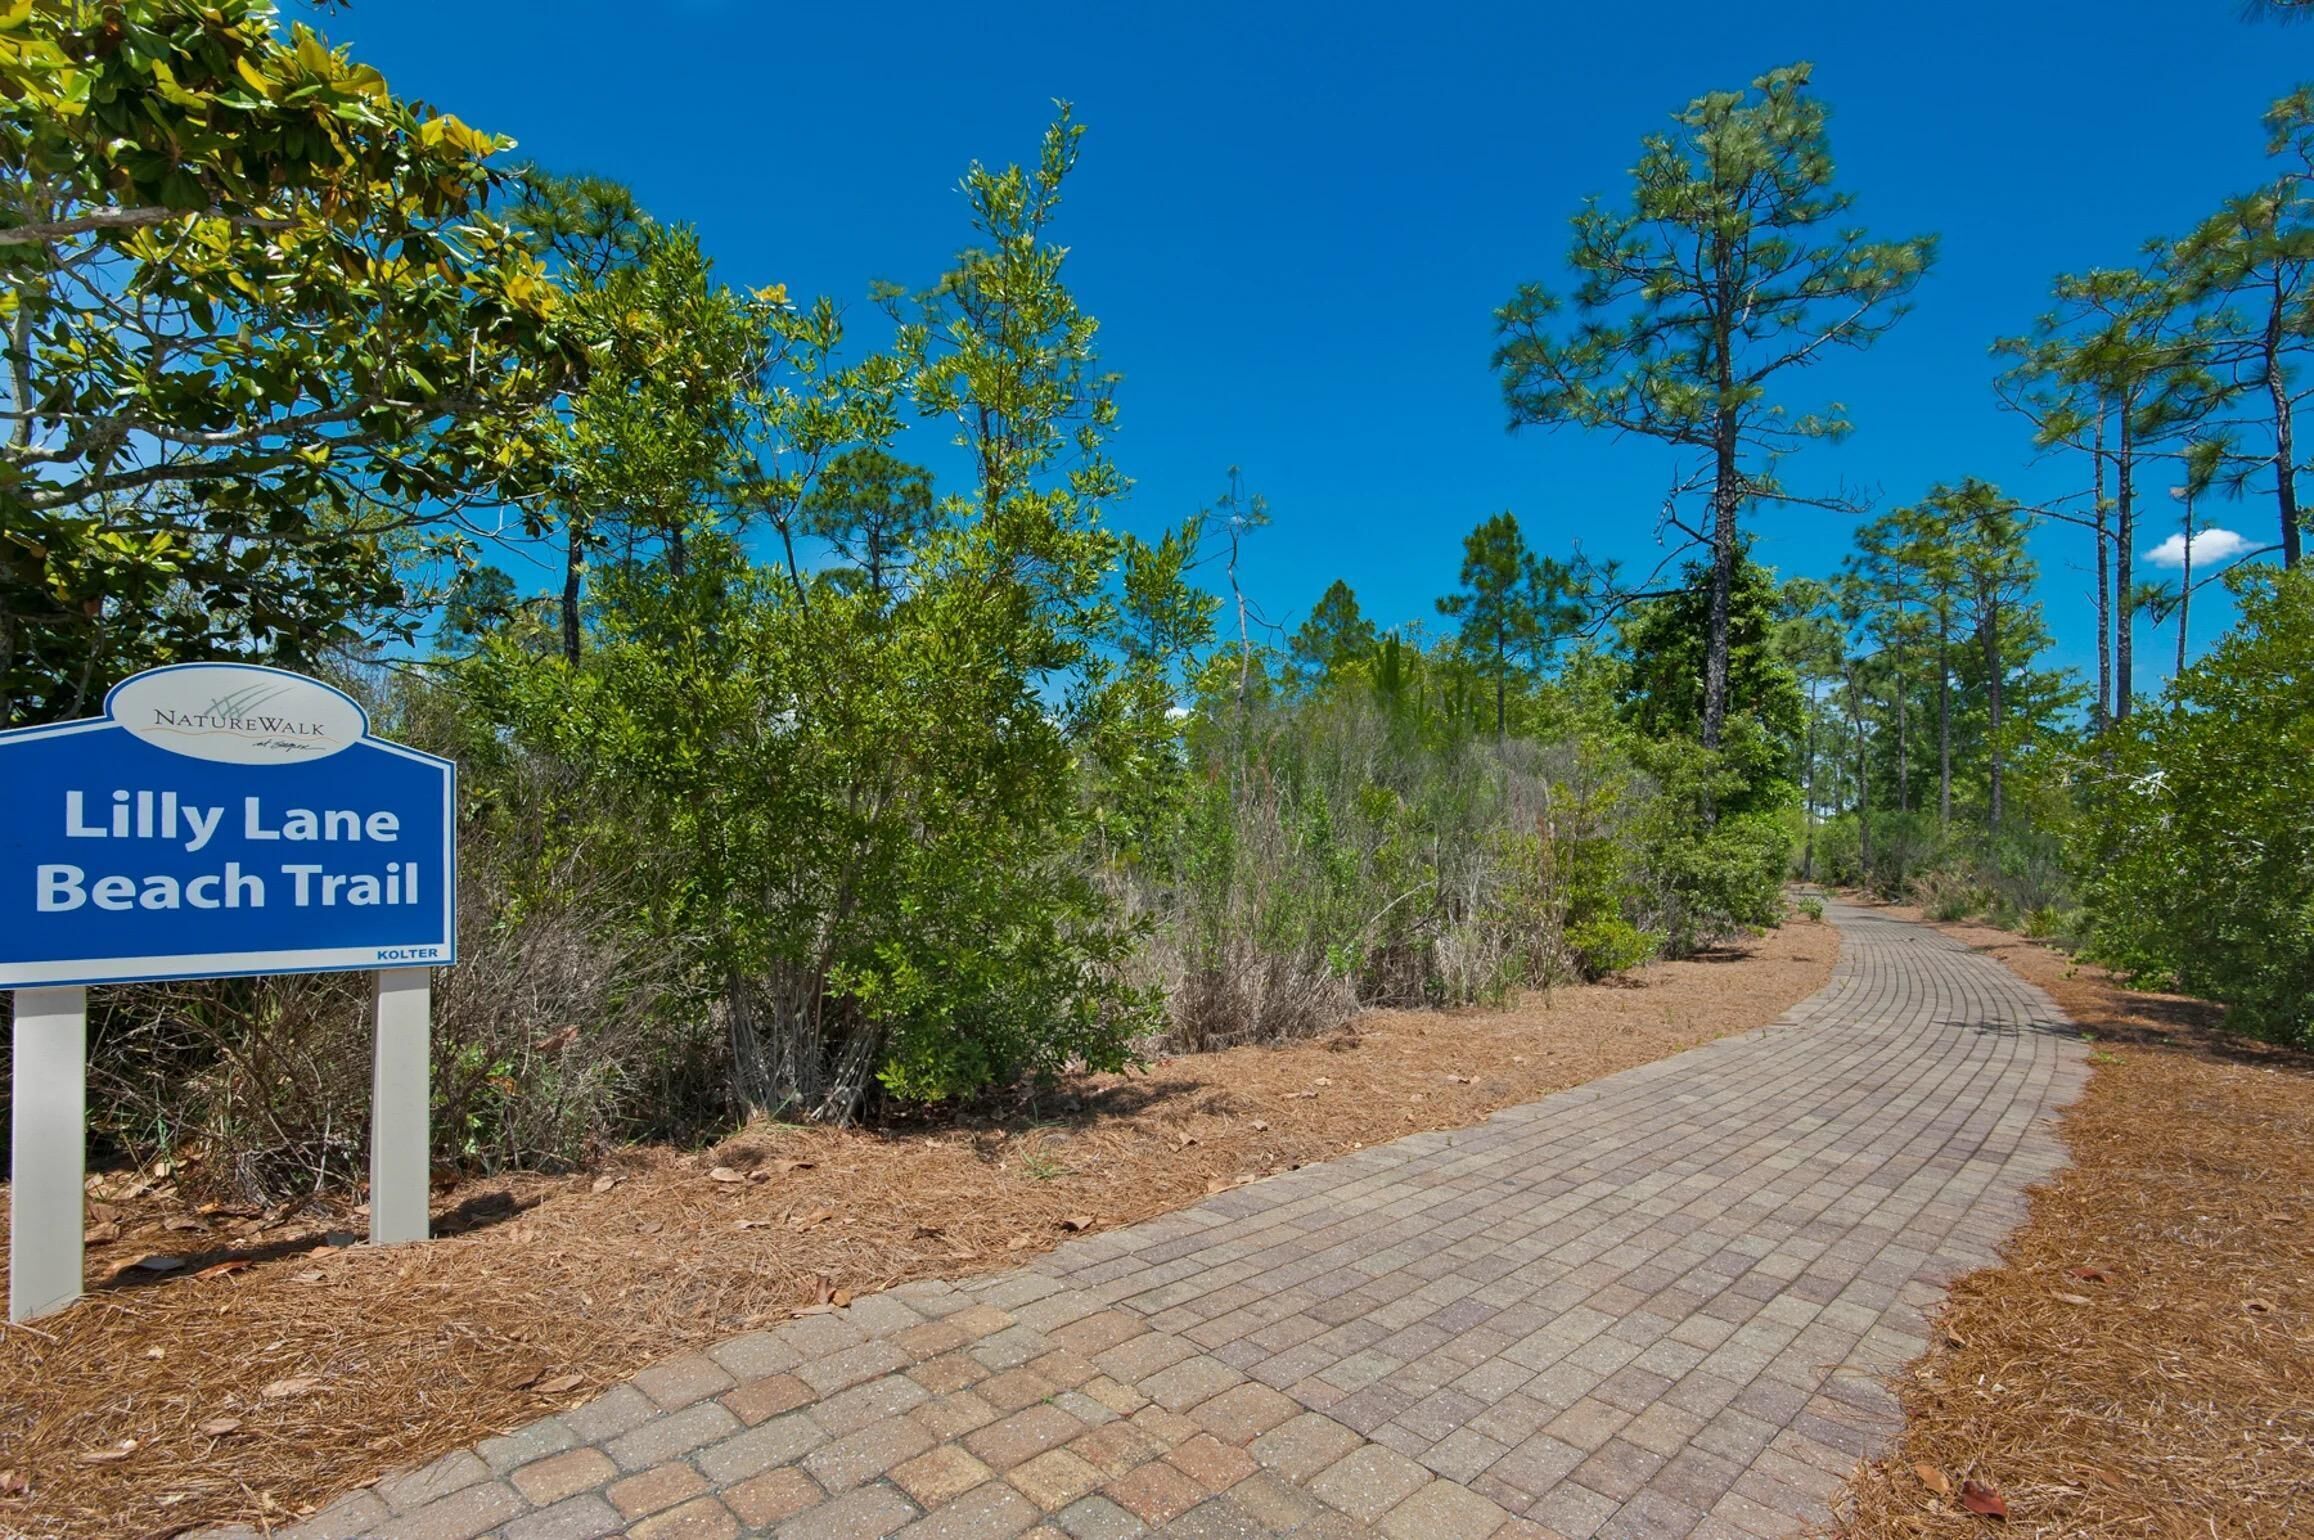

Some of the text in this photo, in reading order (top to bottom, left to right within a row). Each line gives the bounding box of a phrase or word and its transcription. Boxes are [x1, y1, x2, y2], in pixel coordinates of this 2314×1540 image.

[65, 789, 401, 853] Lilly Lane
[36, 861, 419, 913] Beach Trail
[377, 948, 438, 960] KOLTER
